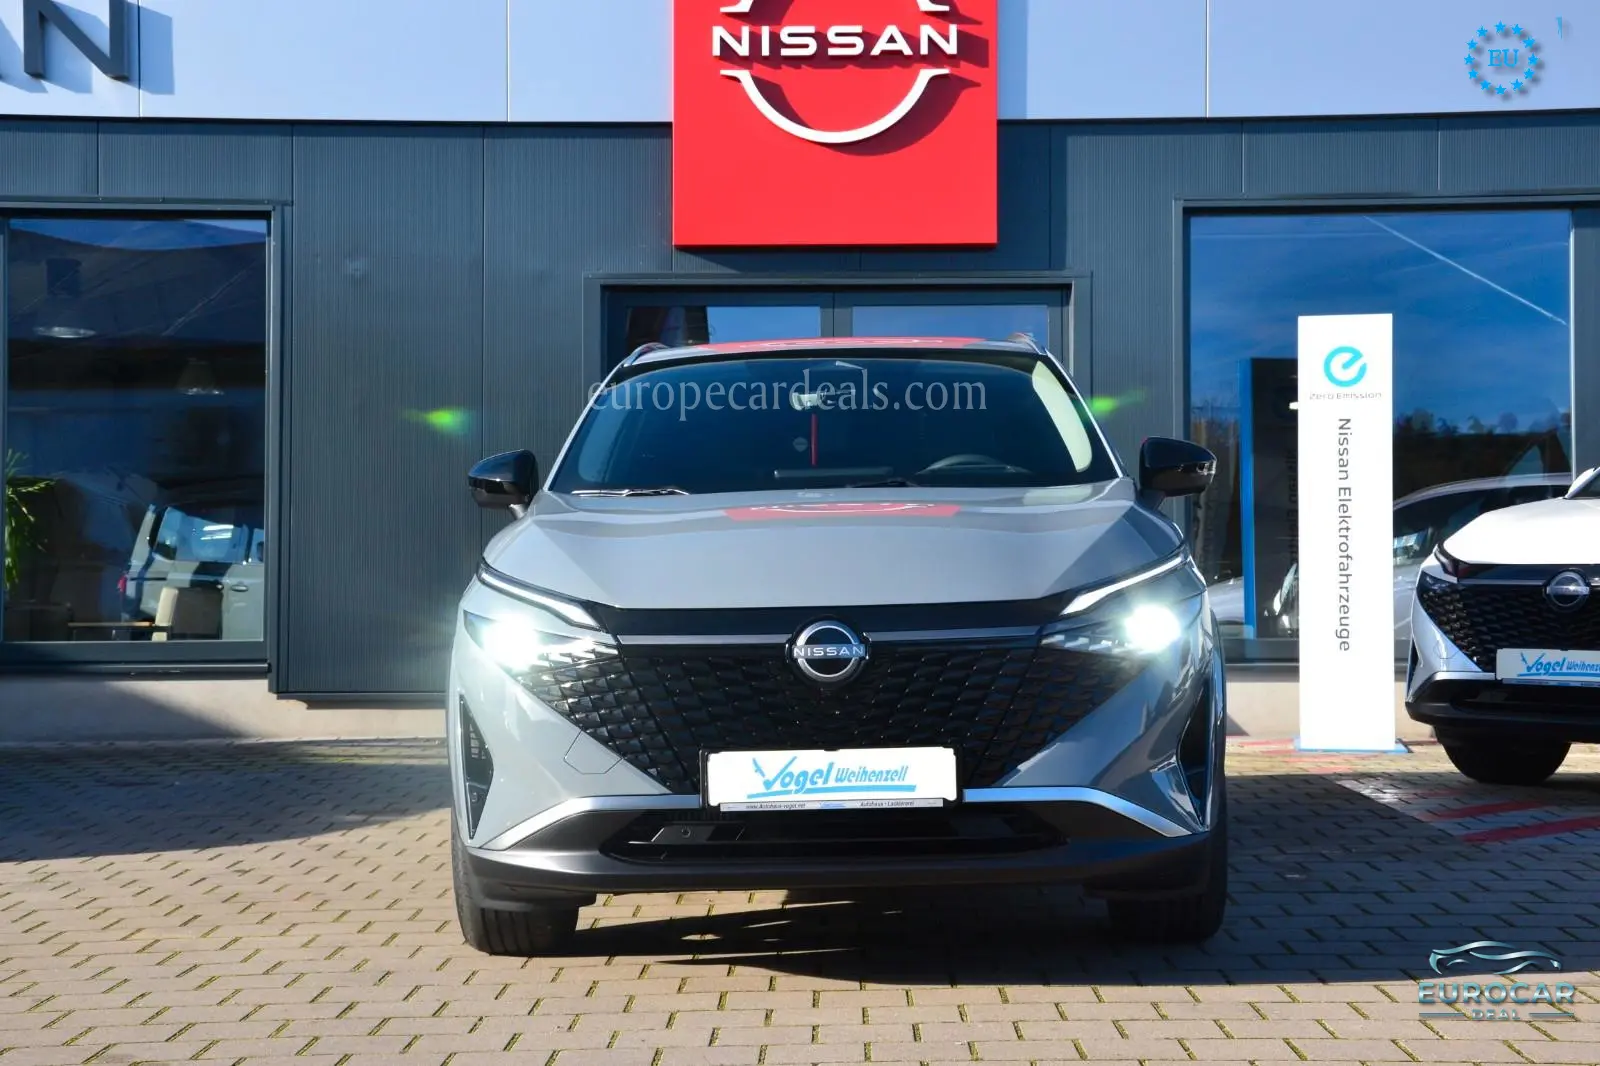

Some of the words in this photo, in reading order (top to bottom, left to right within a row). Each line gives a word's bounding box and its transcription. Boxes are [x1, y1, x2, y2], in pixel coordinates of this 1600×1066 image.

[711, 24, 959, 57] NISSAN
[1309, 392, 1334, 400] Zero
[1336, 391, 1382, 400] Emission
[1337, 418, 1353, 481] Nissan
[1335, 487, 1353, 652] Elektrofahrzeuge
[793, 646, 865, 657] NISSAN
[1520, 652, 1567, 676] Vogel
[752, 756, 835, 794] Vogel
[835, 765, 910, 784] Weihenzell
